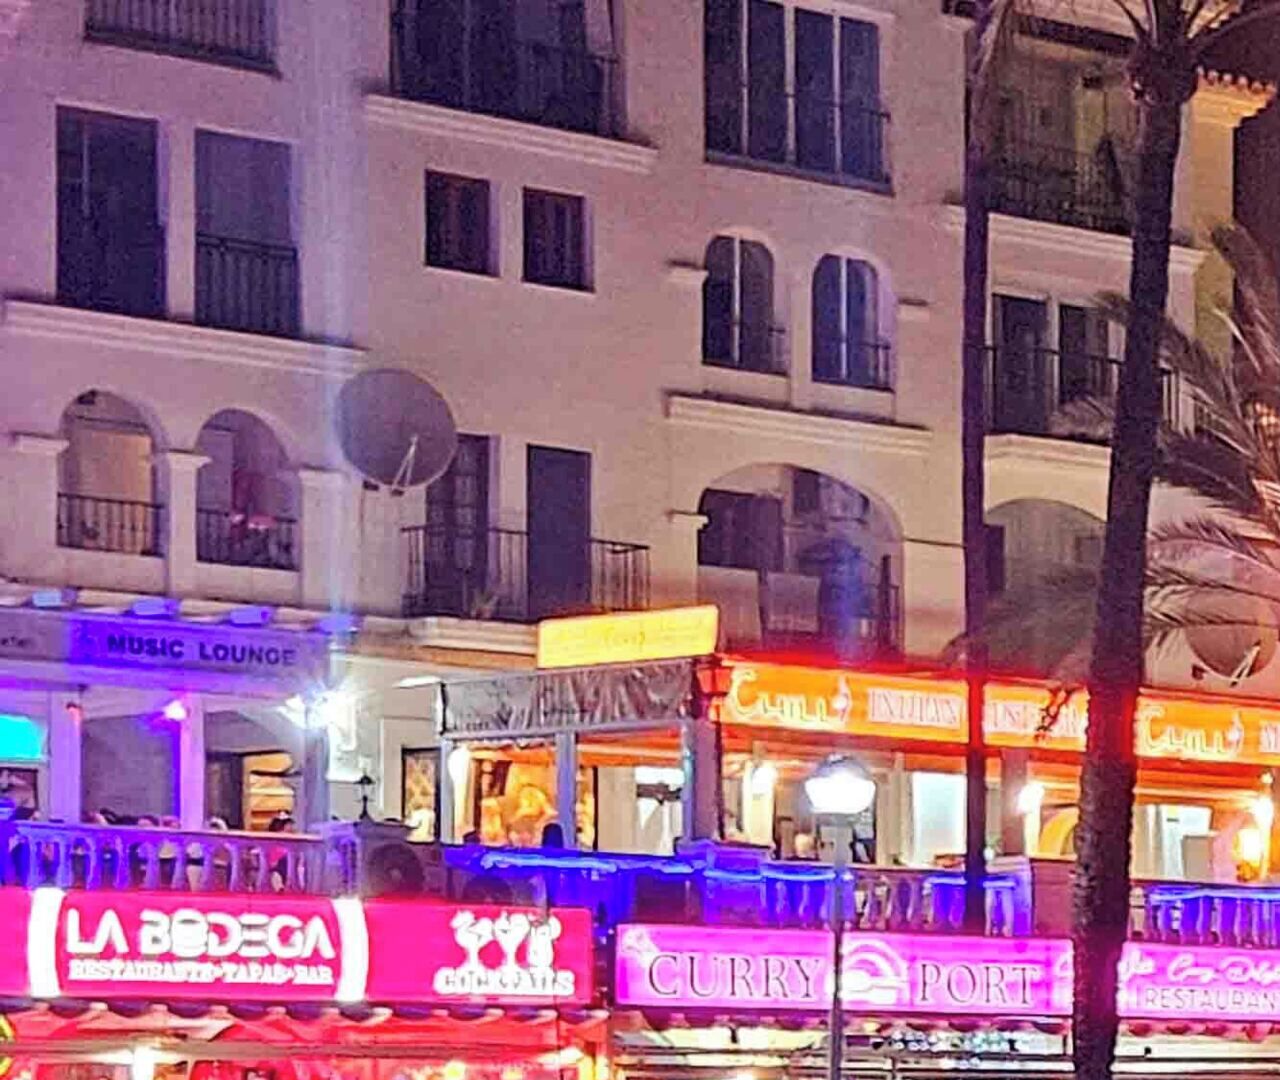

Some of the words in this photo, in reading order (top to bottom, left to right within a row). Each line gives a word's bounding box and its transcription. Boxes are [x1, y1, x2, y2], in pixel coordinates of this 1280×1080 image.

[107, 633, 185, 659] MUSIC
[199, 641, 297, 667] LOUNGE
[66, 908, 130, 954] LA
[138, 908, 336, 959] BODEGA
[647, 952, 821, 999] CURRY
[919, 962, 1039, 1005] PORT
